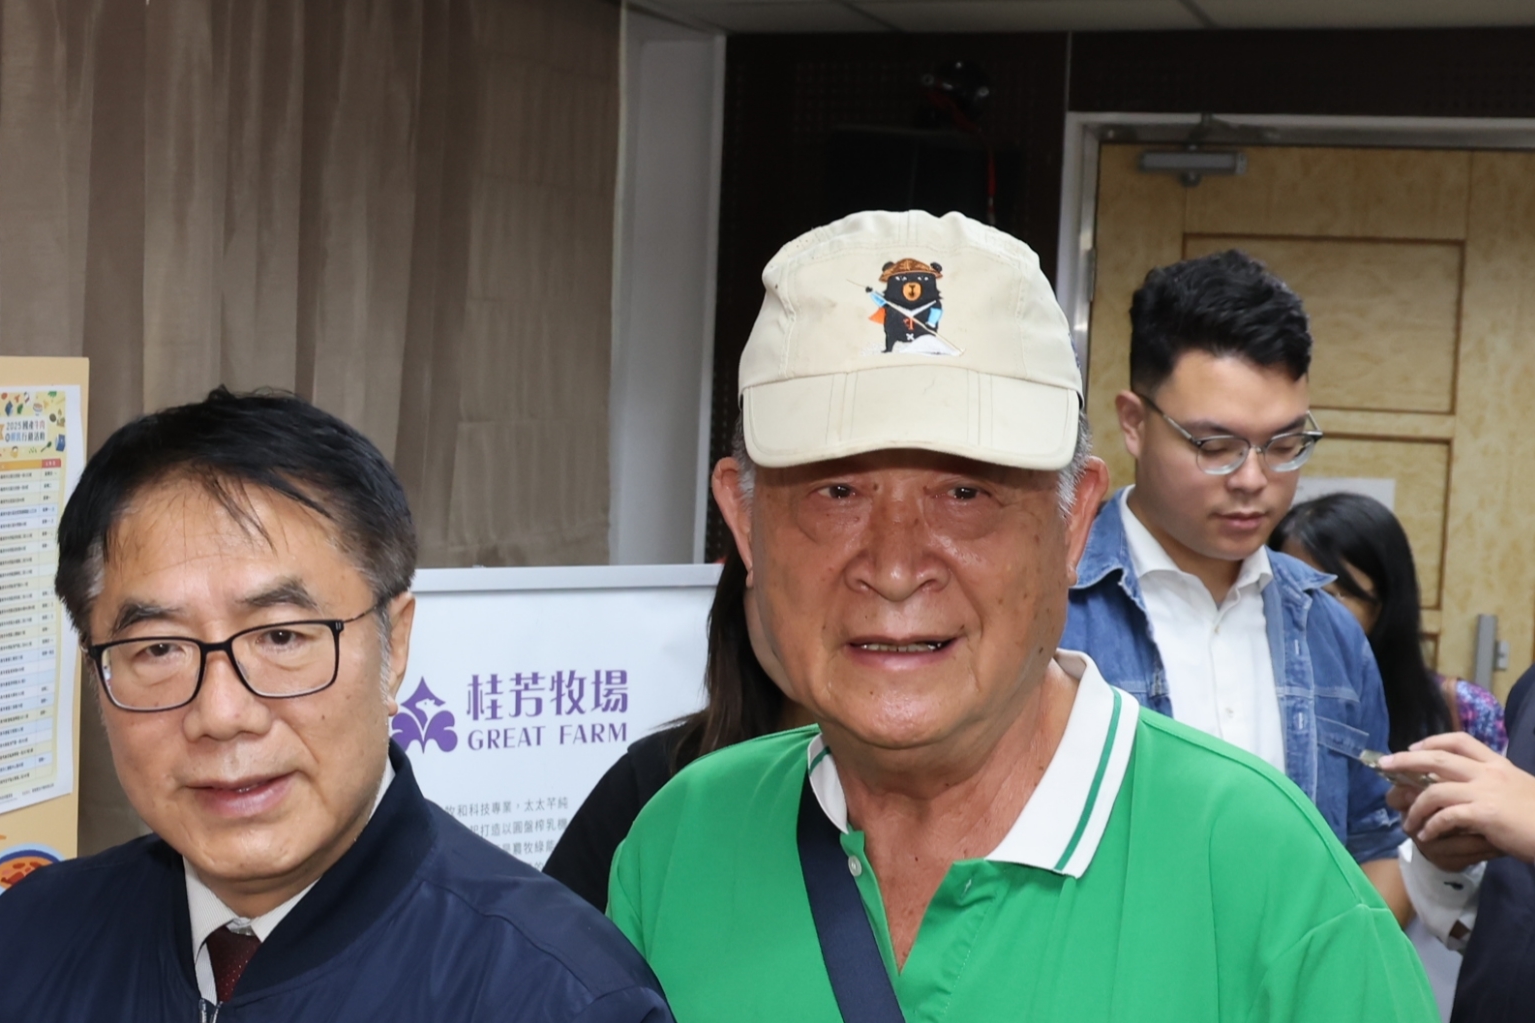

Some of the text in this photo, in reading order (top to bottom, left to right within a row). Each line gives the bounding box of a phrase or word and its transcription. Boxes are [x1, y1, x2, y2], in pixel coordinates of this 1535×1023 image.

[467, 670, 628, 721] 桂芳牧場
[467, 722, 627, 751] GREAT FARM
